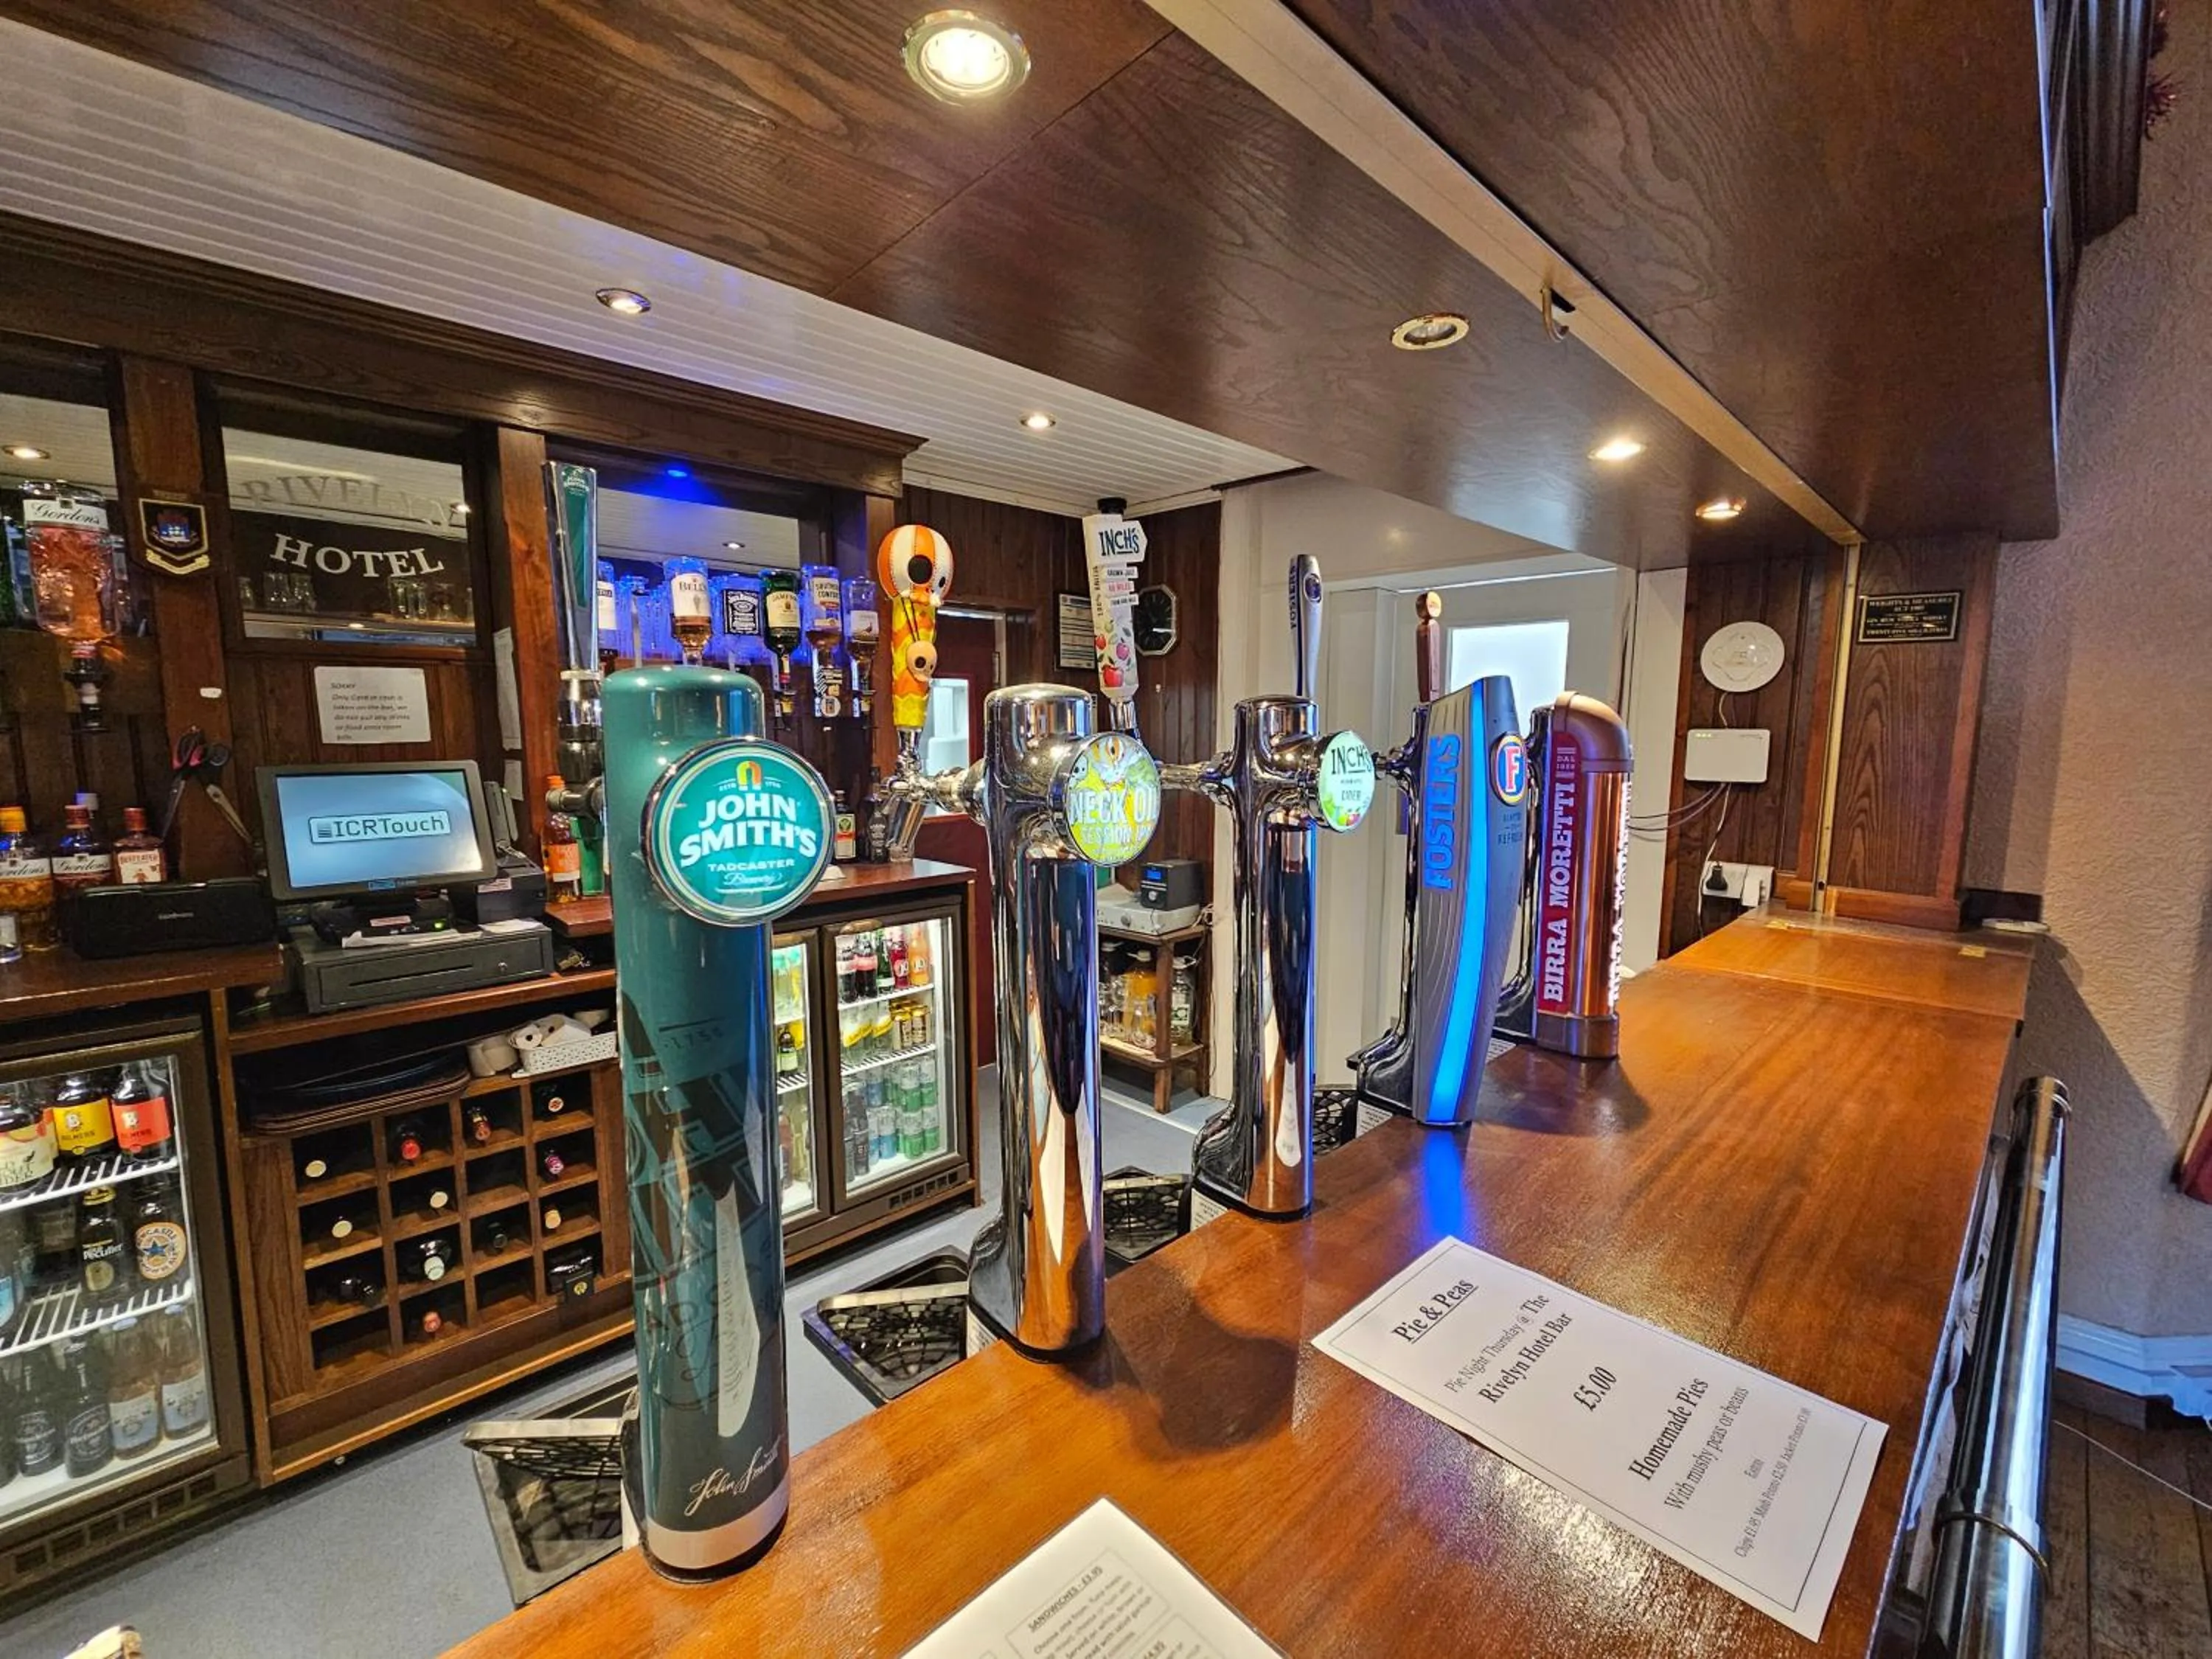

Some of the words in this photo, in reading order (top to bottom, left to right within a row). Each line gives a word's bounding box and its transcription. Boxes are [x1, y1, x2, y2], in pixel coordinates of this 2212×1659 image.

[270, 532, 445, 577] HOTEL
[1098, 527, 1140, 557] INCH'S
[698, 793, 797, 828] JOHN
[1070, 790, 1128, 824] NECK
[334, 815, 444, 838] ICRTouch
[679, 820, 817, 868] SMITH'S
[1549, 782, 1576, 910] MORETTI
[707, 859, 795, 872] TADCASTER
[1543, 919, 1568, 1003] BIRRA
[1391, 1319, 1428, 1342] Pie
[1419, 1305, 1443, 1321] &
[1431, 1279, 1474, 1308] Peas
[1444, 1378, 1467, 1393] Pie
[1458, 1354, 1489, 1380] Night
[1482, 1323, 1525, 1357] Thursday
[1520, 1295, 1550, 1315] The
[1478, 1360, 1531, 1404] Rivelyn
[1518, 1328, 1557, 1363] Hotel
[1545, 1313, 1573, 1334] Bar
[1573, 1366, 1617, 1412] £5.00
[1720, 1386, 1750, 1415] beans
[1628, 1405, 1693, 1481] Homemade
[1675, 1378, 1709, 1408] Pies
[1719, 1412, 1735, 1427] or
[1706, 1425, 1728, 1453] peas
[1687, 1447, 1719, 1484] mushy
[1664, 1481, 1695, 1510] With
